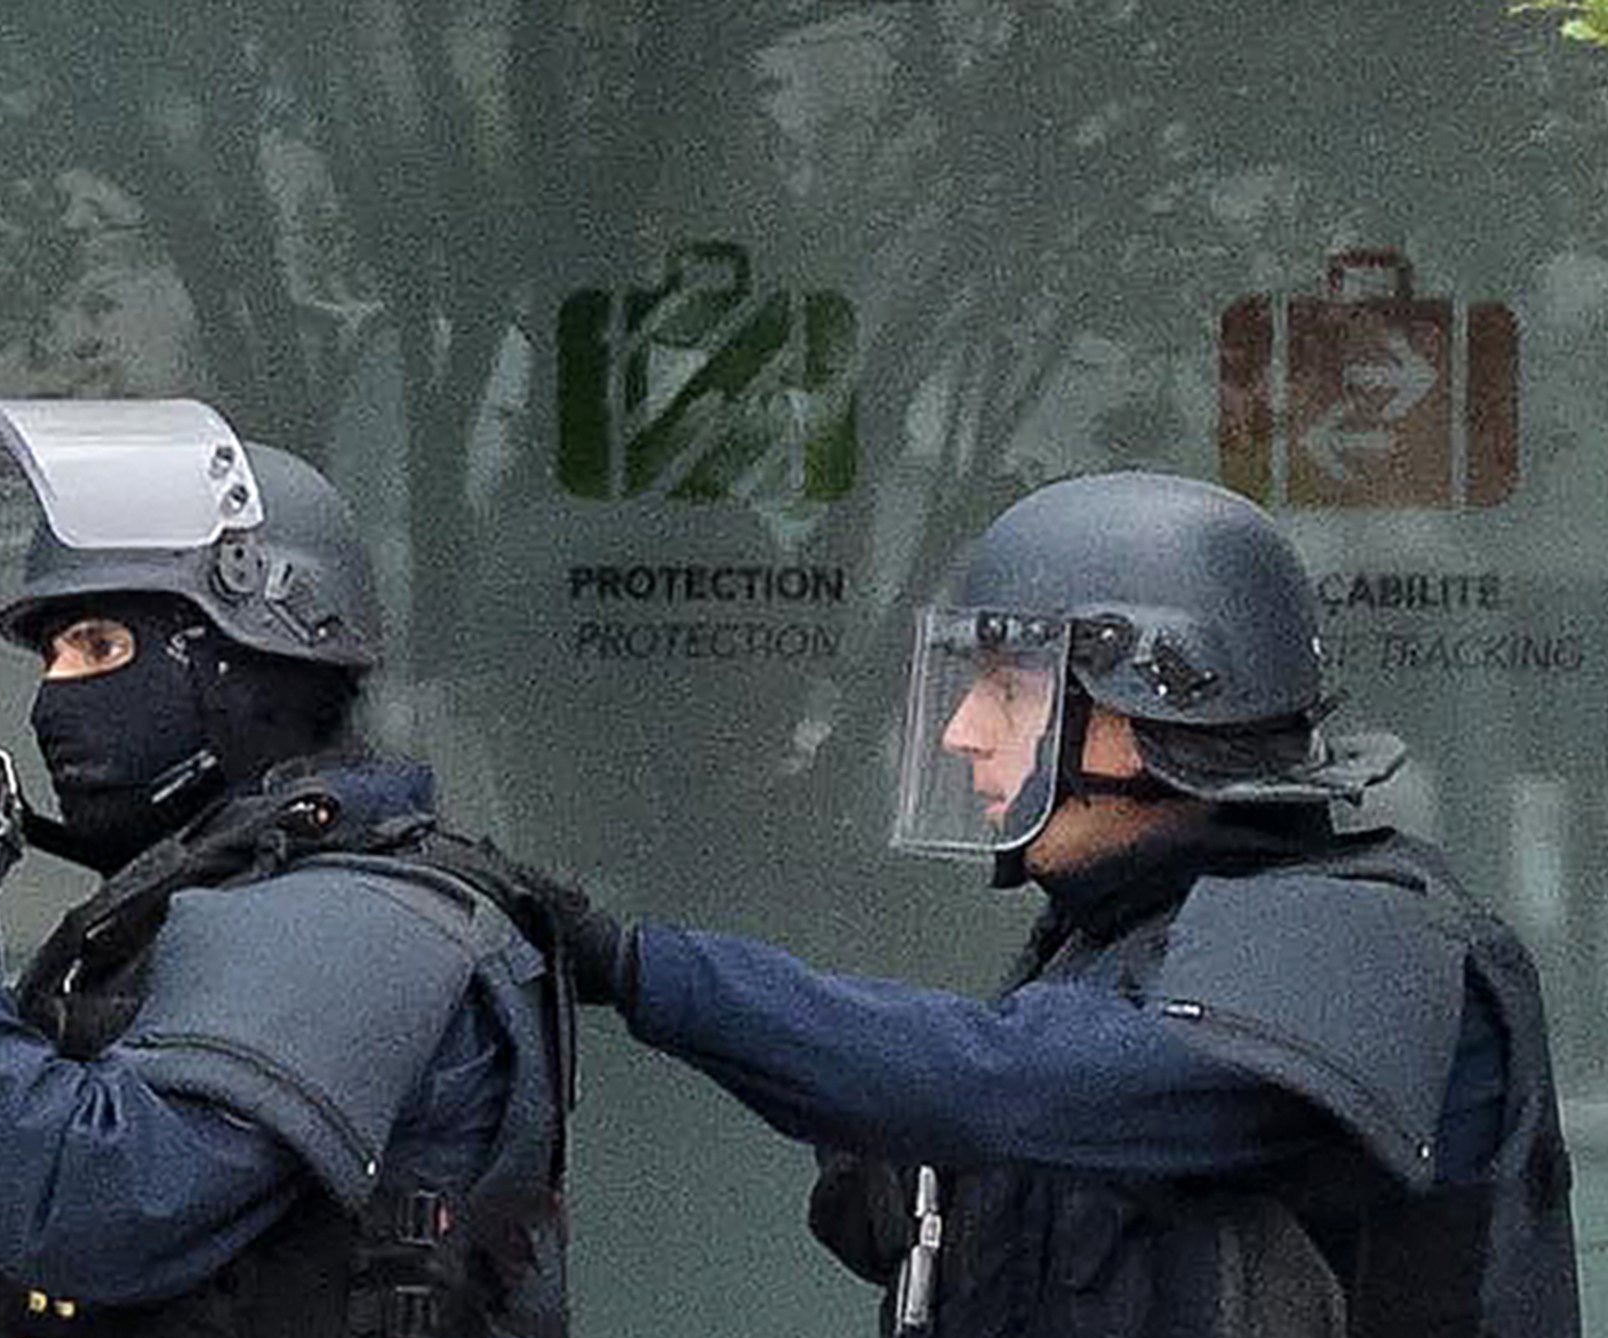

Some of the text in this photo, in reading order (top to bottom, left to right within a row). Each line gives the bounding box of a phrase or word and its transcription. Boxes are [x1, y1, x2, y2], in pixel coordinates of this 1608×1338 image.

[567, 565, 845, 602] PROTECTION
[1316, 571, 1505, 614] ÇABILITE
[579, 622, 840, 658] PROTECTION
